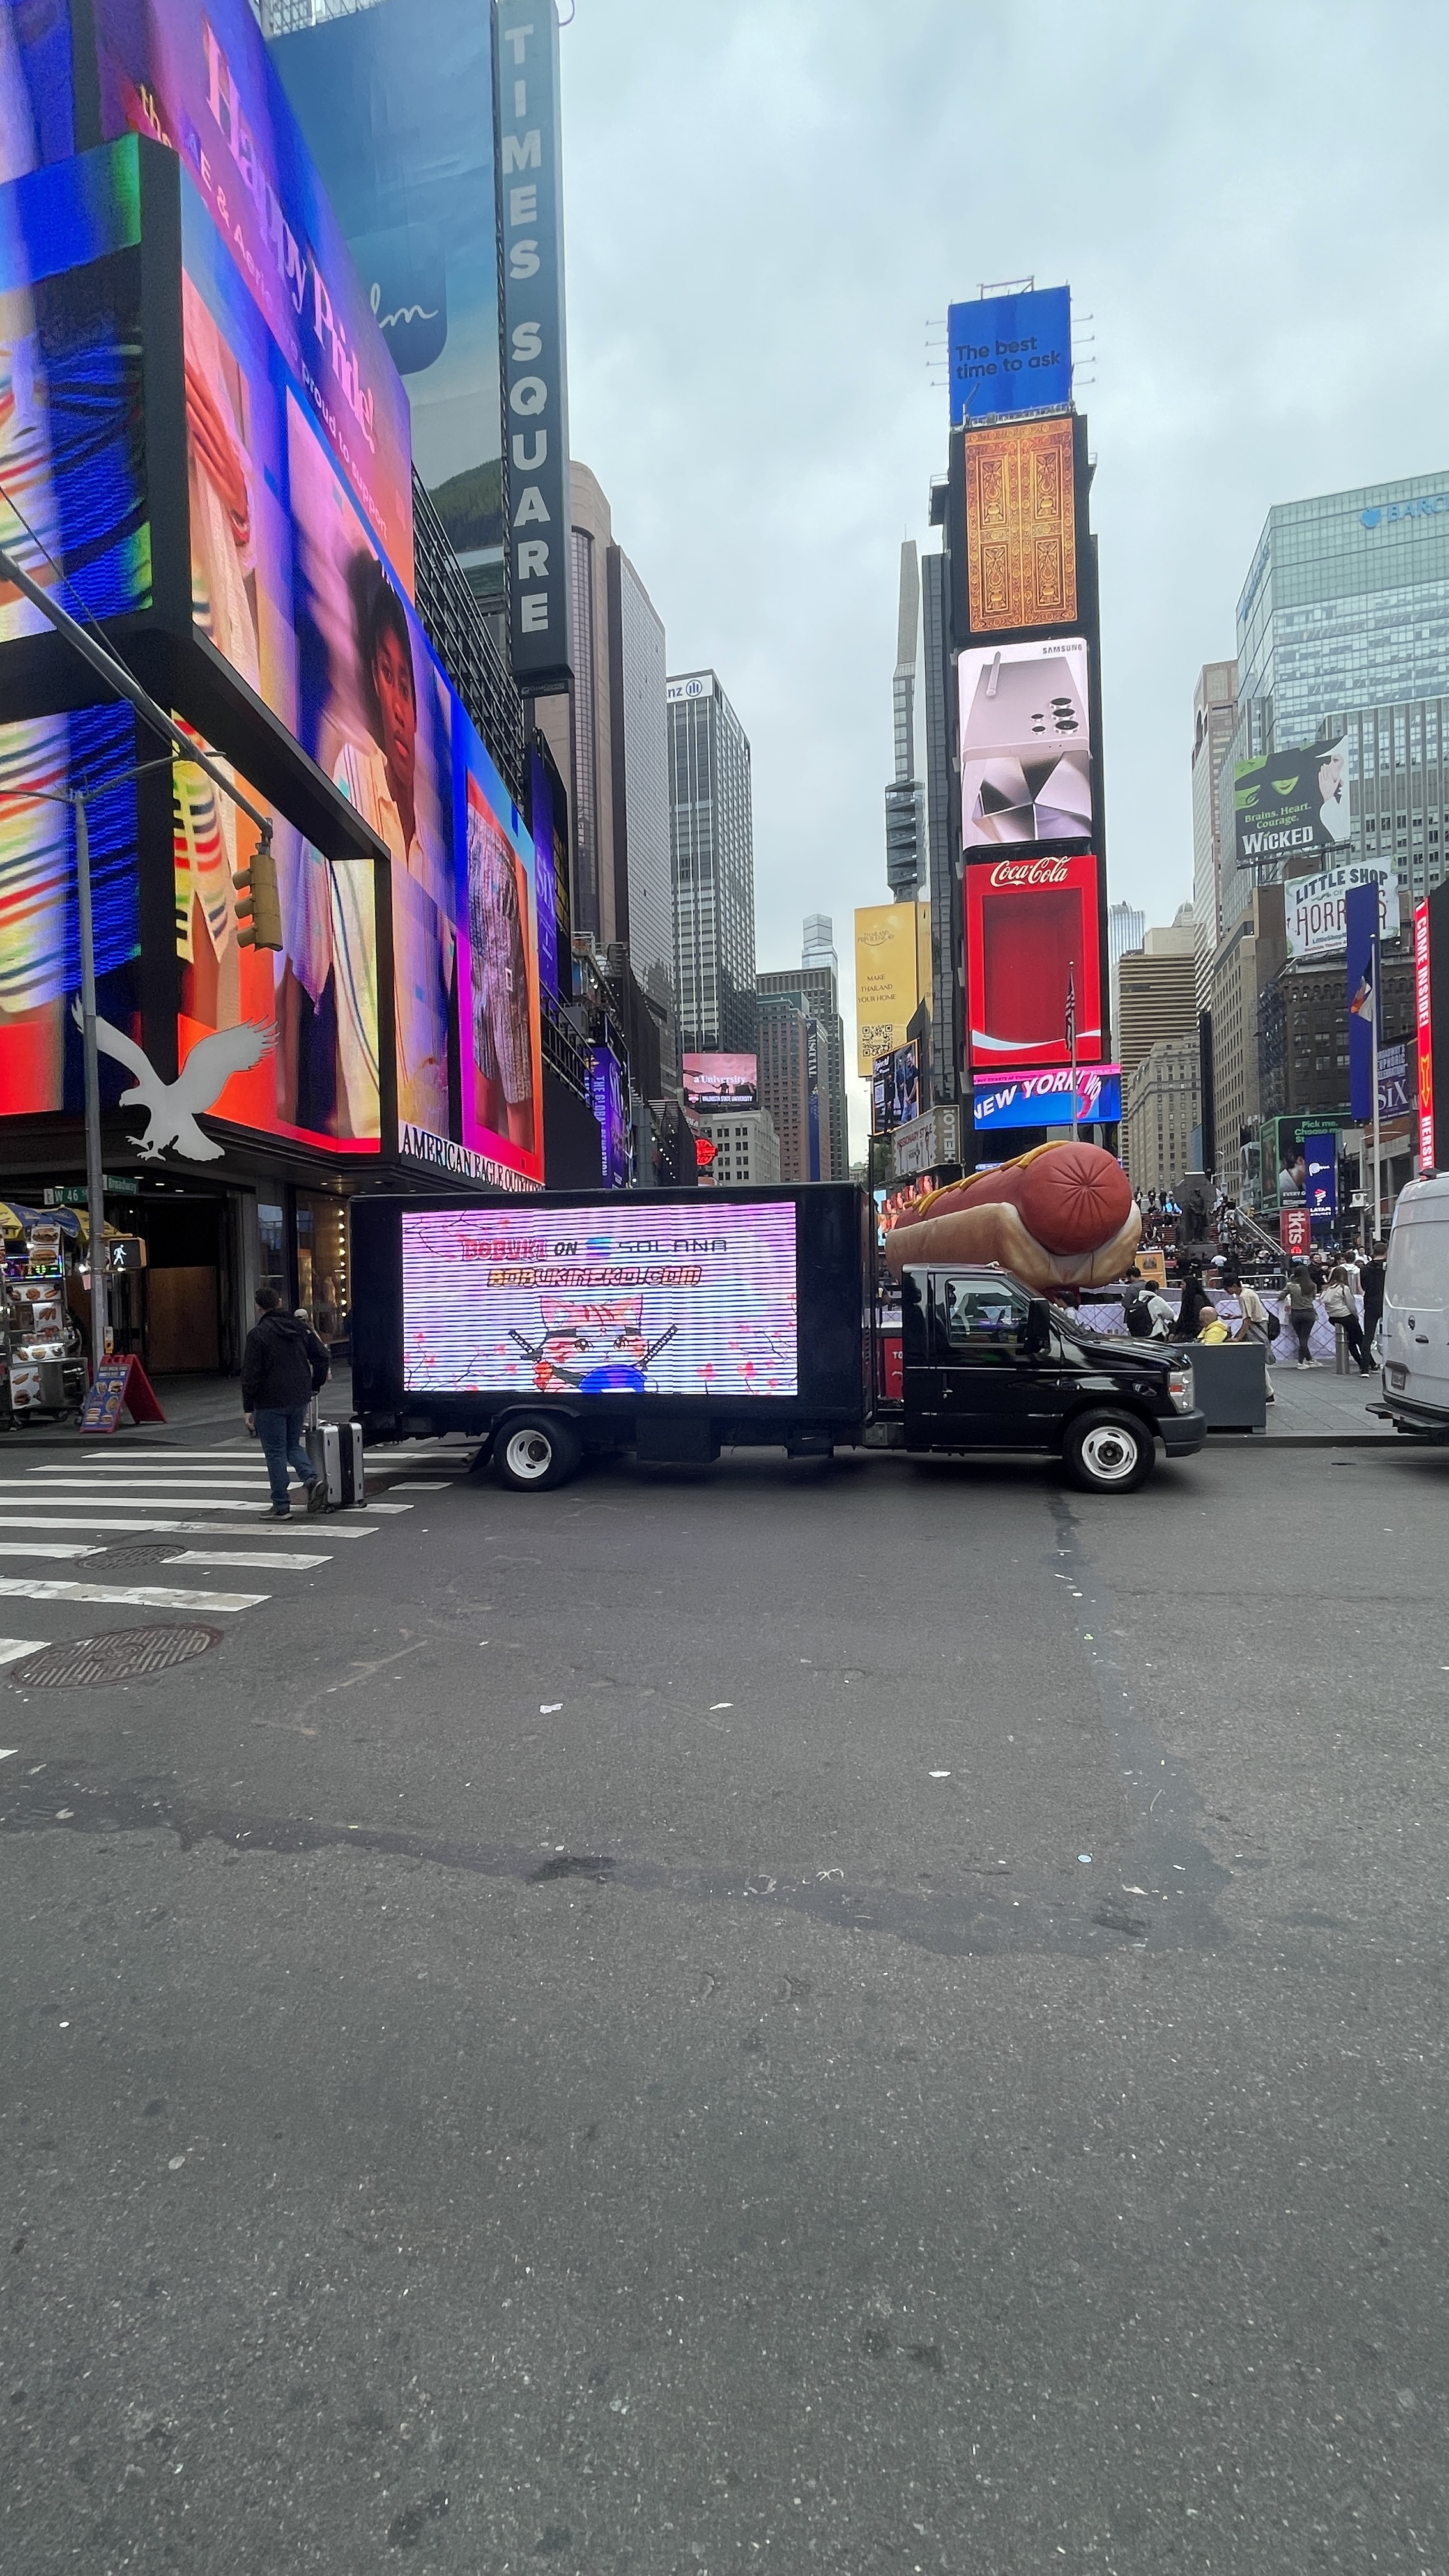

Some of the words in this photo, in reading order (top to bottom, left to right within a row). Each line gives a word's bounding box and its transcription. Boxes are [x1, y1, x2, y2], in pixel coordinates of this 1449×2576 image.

[502, 24, 542, 280] TIMES
[956, 345, 990, 362] The
[995, 337, 1038, 356] best
[956, 362, 998, 379] time
[1003, 358, 1022, 372] to
[1028, 350, 1061, 369] ask
[338, 431, 350, 463] to
[510, 321, 551, 632] SQUARE
[1043, 644, 1082, 654] SAMSUNG
[1245, 810, 1279, 823] Brains.
[1280, 802, 1312, 816] Heart.
[1257, 815, 1300, 829] Courage.
[990, 855, 1072, 887] Coca-Cola
[1296, 870, 1346, 905] LITTLE
[1349, 868, 1388, 885] SHOP
[1416, 916, 1428, 965] COME
[861, 984, 893, 993] THAILAND
[1418, 965, 1429, 1028] INSIDE!
[702, 1075, 746, 1085] University
[974, 1085, 1017, 1119] NEW
[1023, 1070, 1085, 1099] YORK!
[943, 1110, 956, 1162] HELLO!
[401, 1124, 472, 1177] AMERICAN
[474, 1154, 503, 1187] EAGLE
[55, 1191, 63, 1202] W
[67, 1190, 78, 1201] 46
[108, 1178, 137, 1194] Broadway
[1289, 1211, 1306, 1244] tkts
[554, 1241, 578, 1255] ON
[618, 1240, 728, 1253] SOLANA
